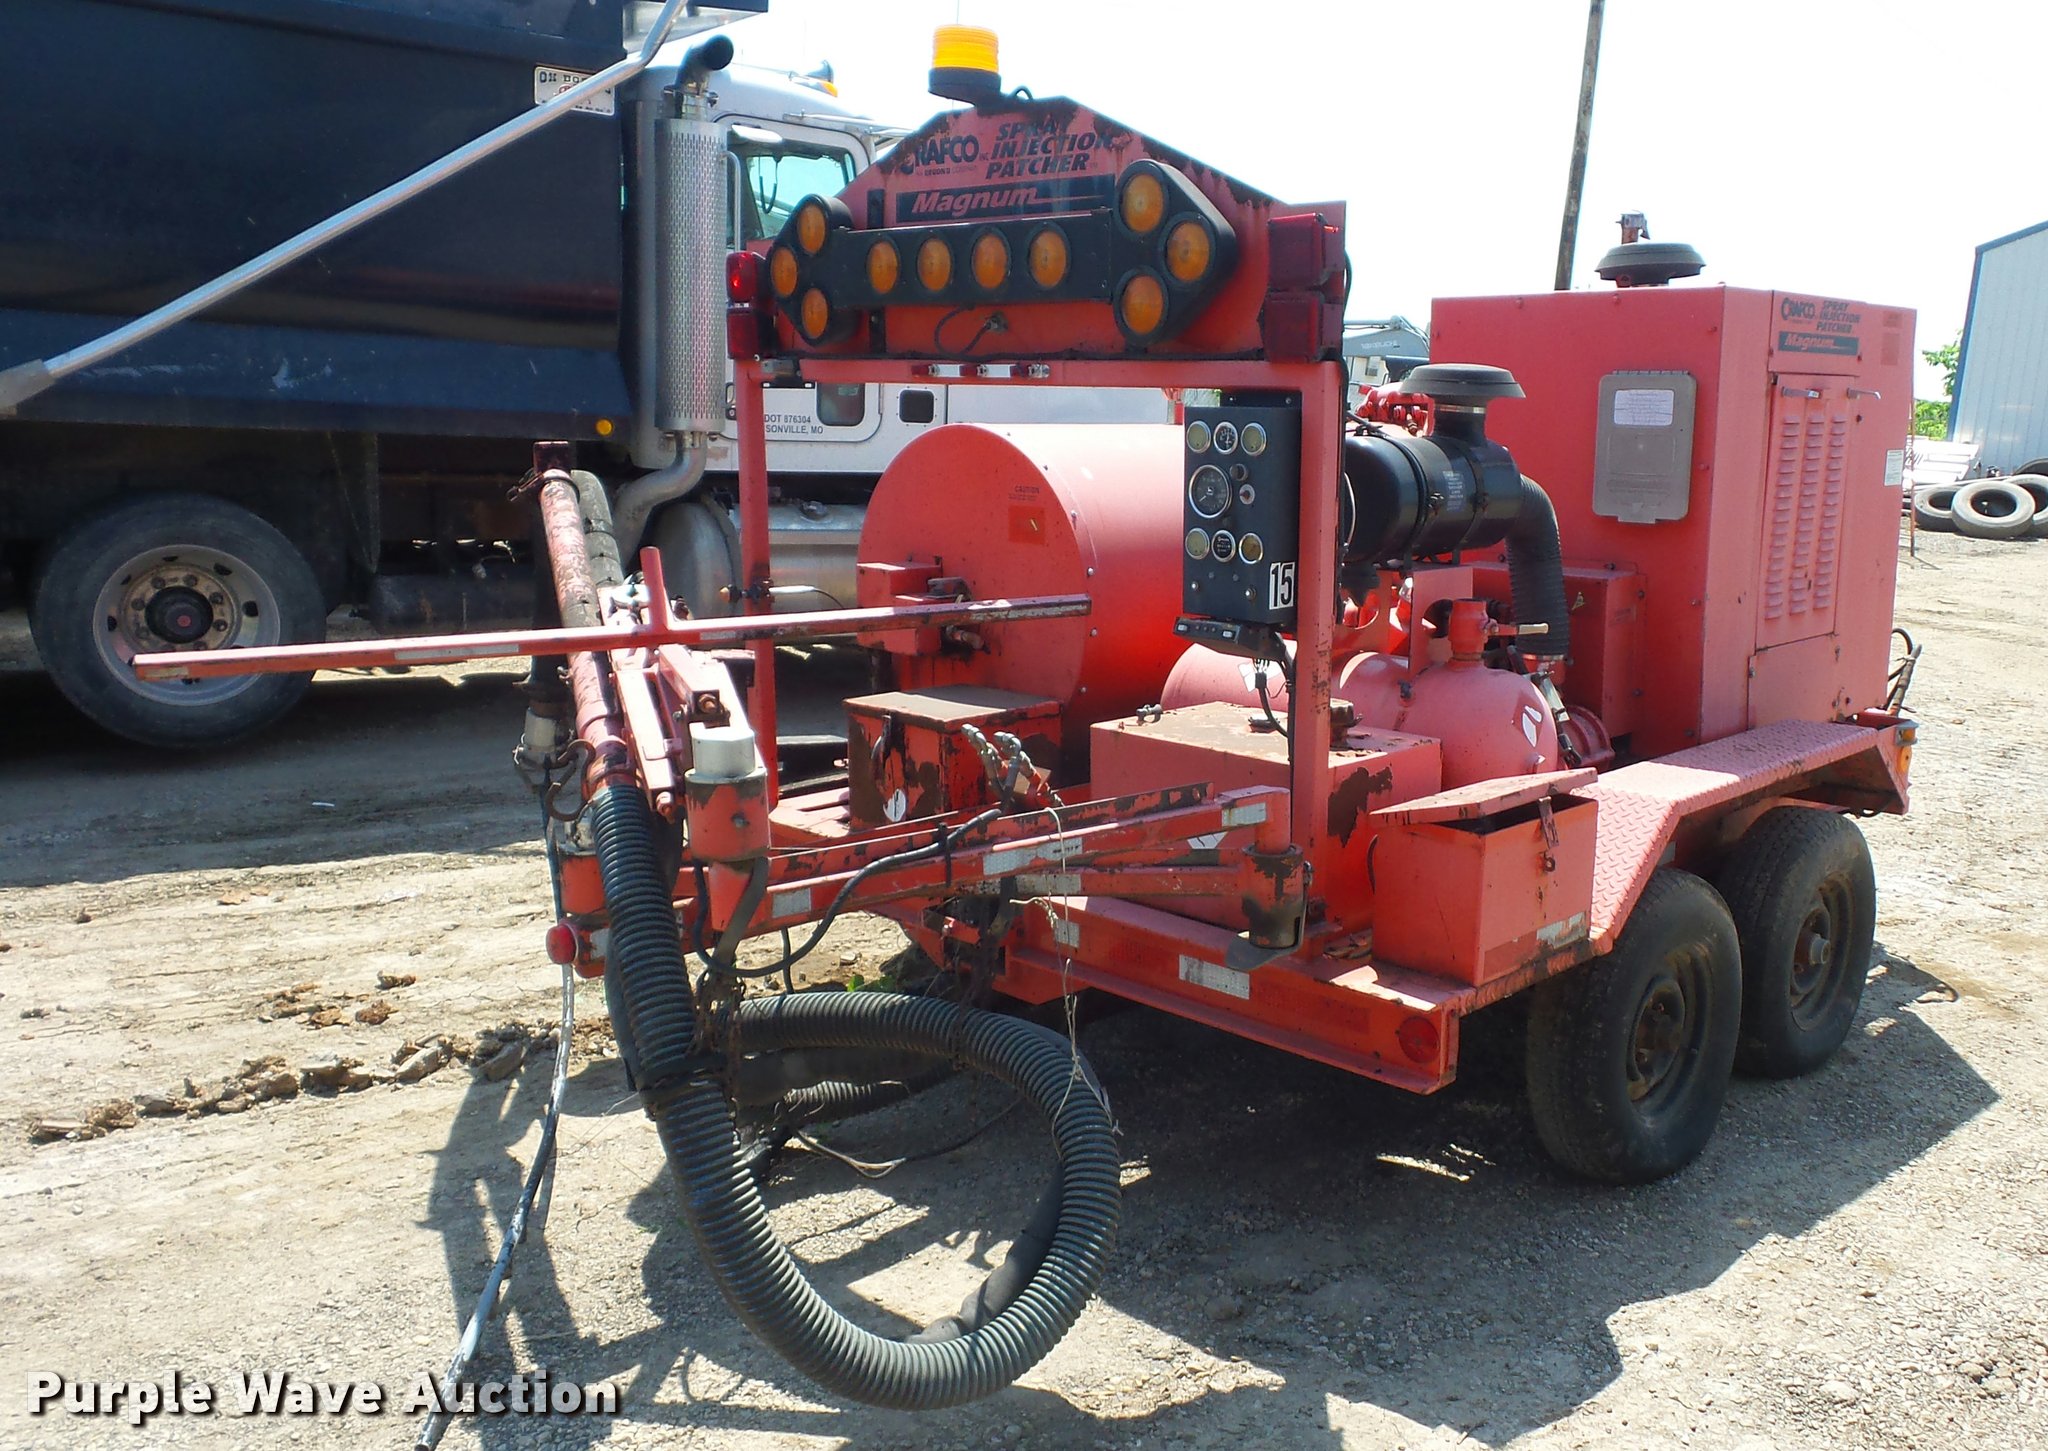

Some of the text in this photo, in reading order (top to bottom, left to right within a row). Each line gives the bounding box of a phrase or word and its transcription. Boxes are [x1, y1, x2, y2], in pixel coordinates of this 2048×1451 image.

[986, 153, 1090, 179] PATCHER
[911, 187, 1038, 217] Magnum
[1784, 333, 1835, 350] Magnum
[764, 414, 781, 423] DOT
[811, 425, 823, 434] MO
[1271, 563, 1293, 607] 15
